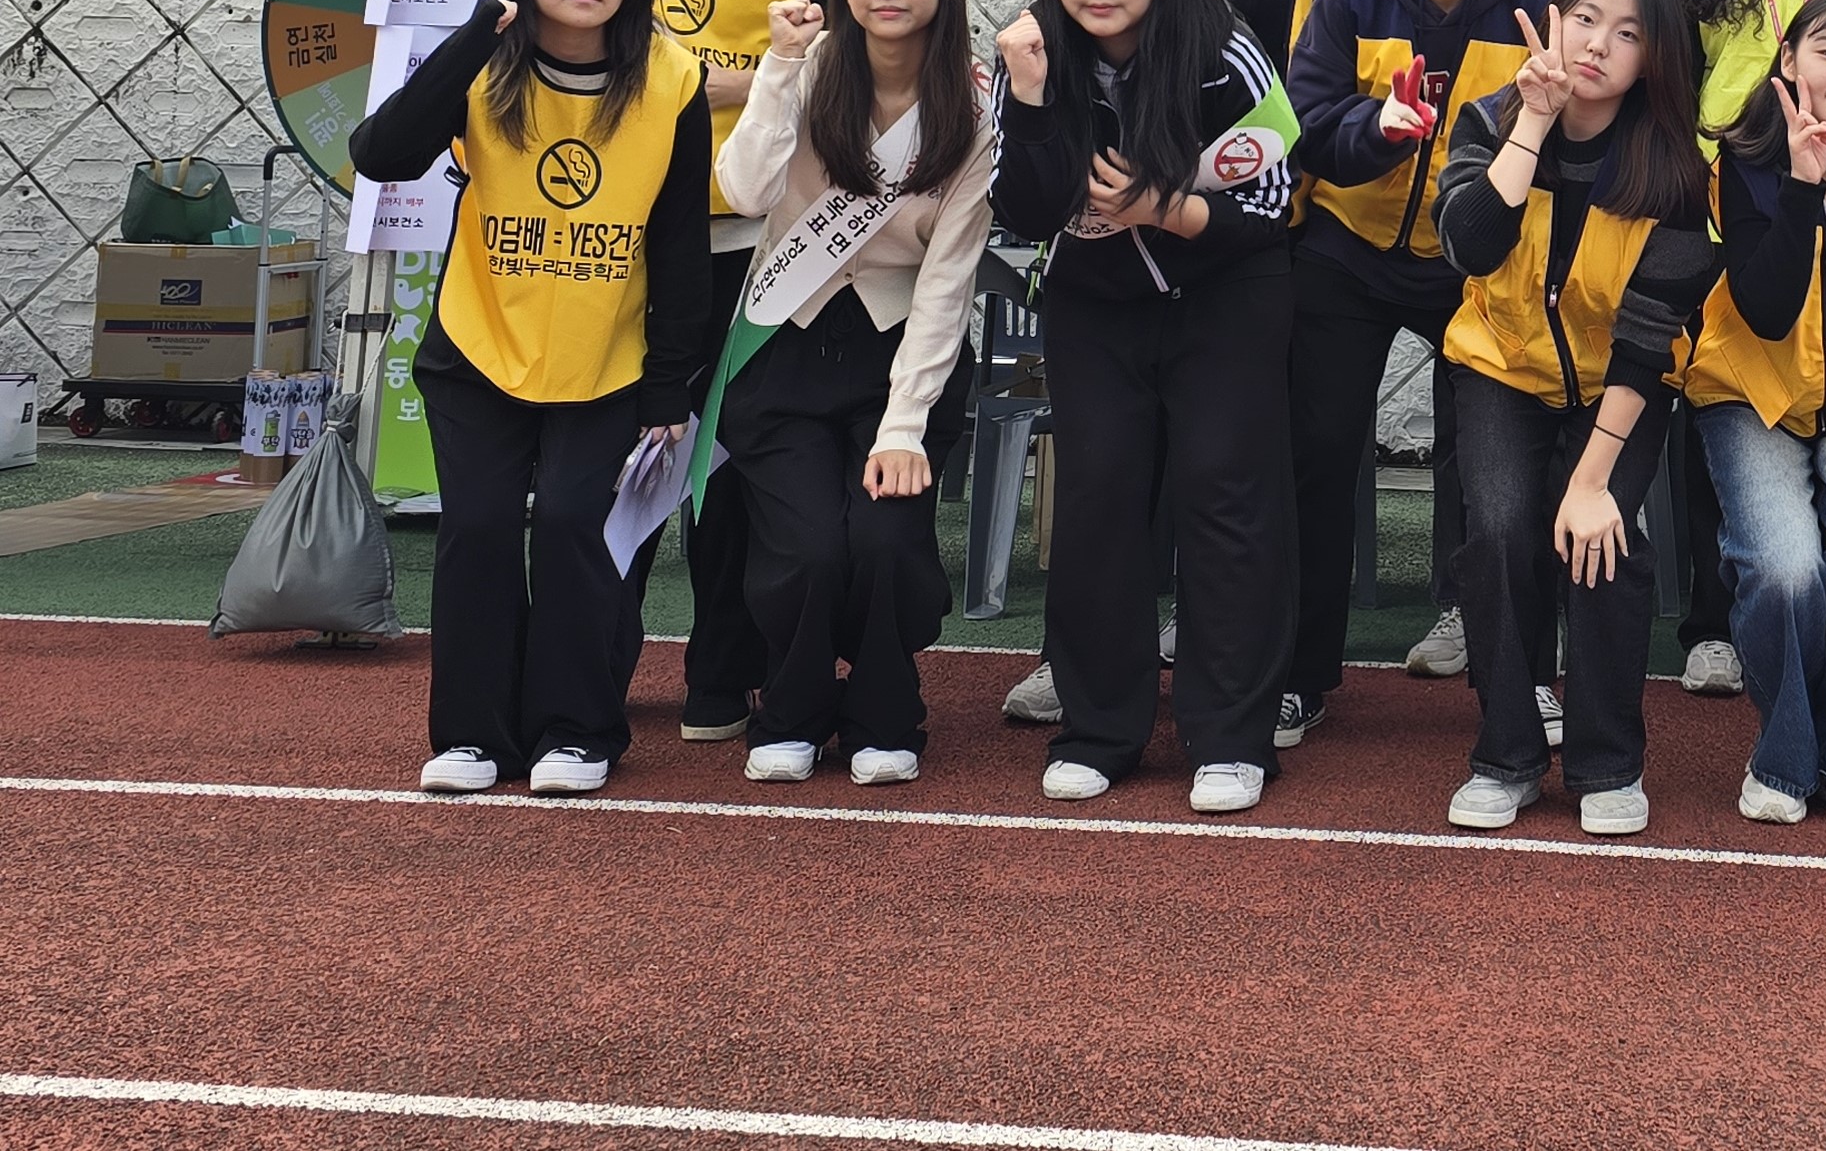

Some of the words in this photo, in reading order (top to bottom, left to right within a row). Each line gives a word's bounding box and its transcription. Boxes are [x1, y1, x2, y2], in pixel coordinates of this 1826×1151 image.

[286, 25, 310, 68] 금연
[313, 22, 338, 65] 실천
[488, 254, 629, 283] 한빛누리고등학교
